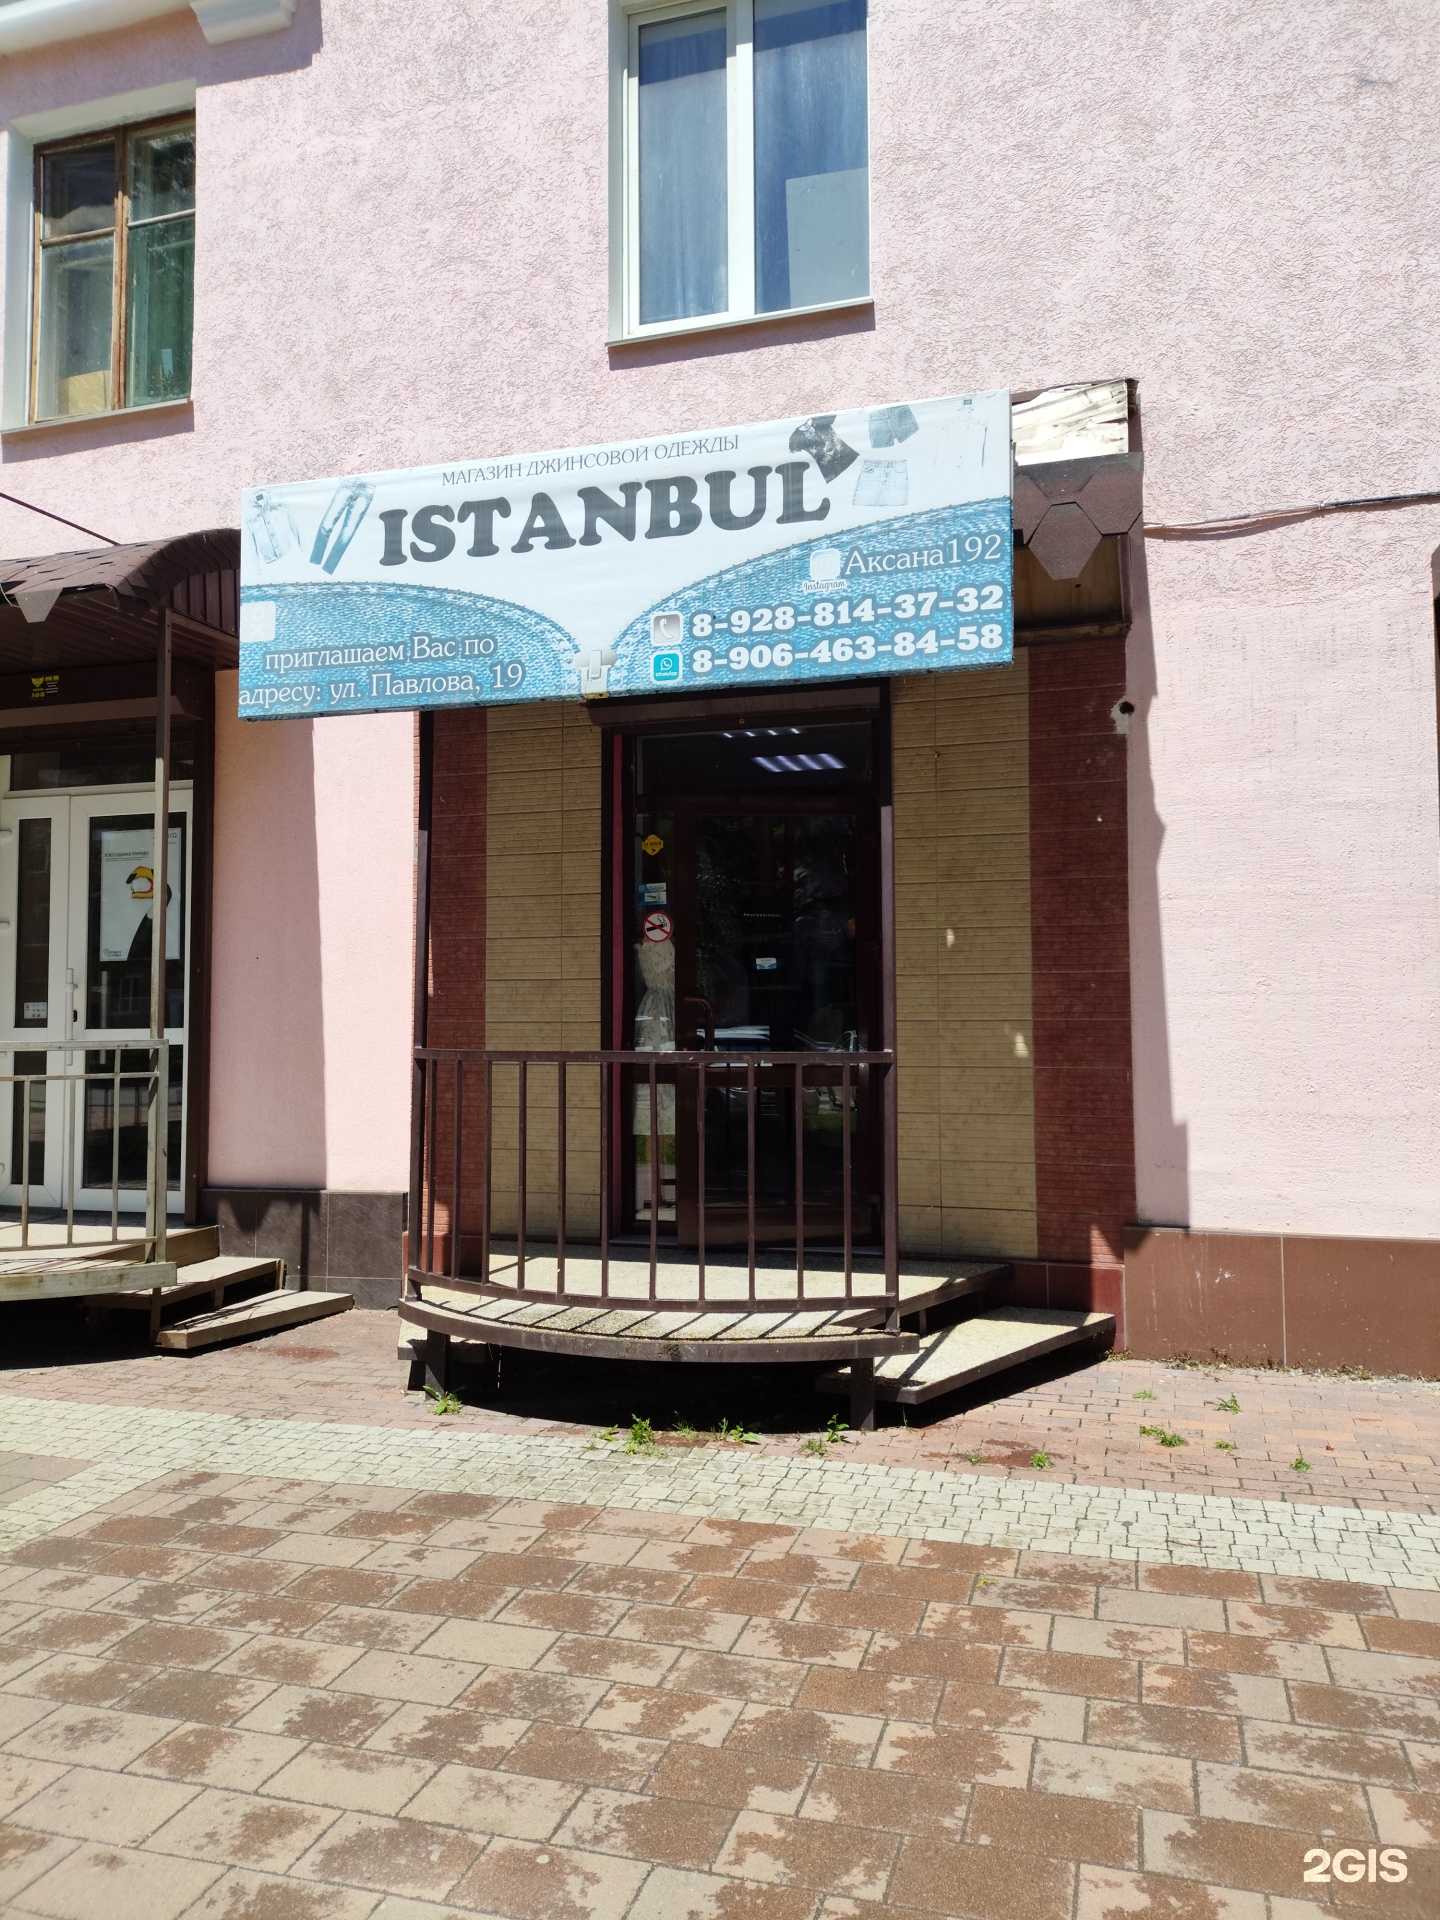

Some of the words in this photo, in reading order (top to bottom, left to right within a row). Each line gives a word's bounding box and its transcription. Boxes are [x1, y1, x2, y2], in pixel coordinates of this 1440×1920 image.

[442, 463, 522, 487] МАГАЗИН
[527, 444, 649, 477] ДЖИНСОВОЙ
[654, 434, 739, 460] ОДЕЖДЫ
[378, 461, 831, 567] ISTANBUL
[691, 585, 1004, 637] 8-928-814-37-32
[265, 644, 404, 673] приглашаем
[412, 635, 456, 660] Вас
[464, 637, 495, 656] по
[691, 624, 1004, 673] 8-906-463-84-58
[239, 684, 322, 709] адресу:
[330, 682, 360, 705] ул.
[371, 672, 482, 699] Павлова,
[491, 662, 524, 689] 19
